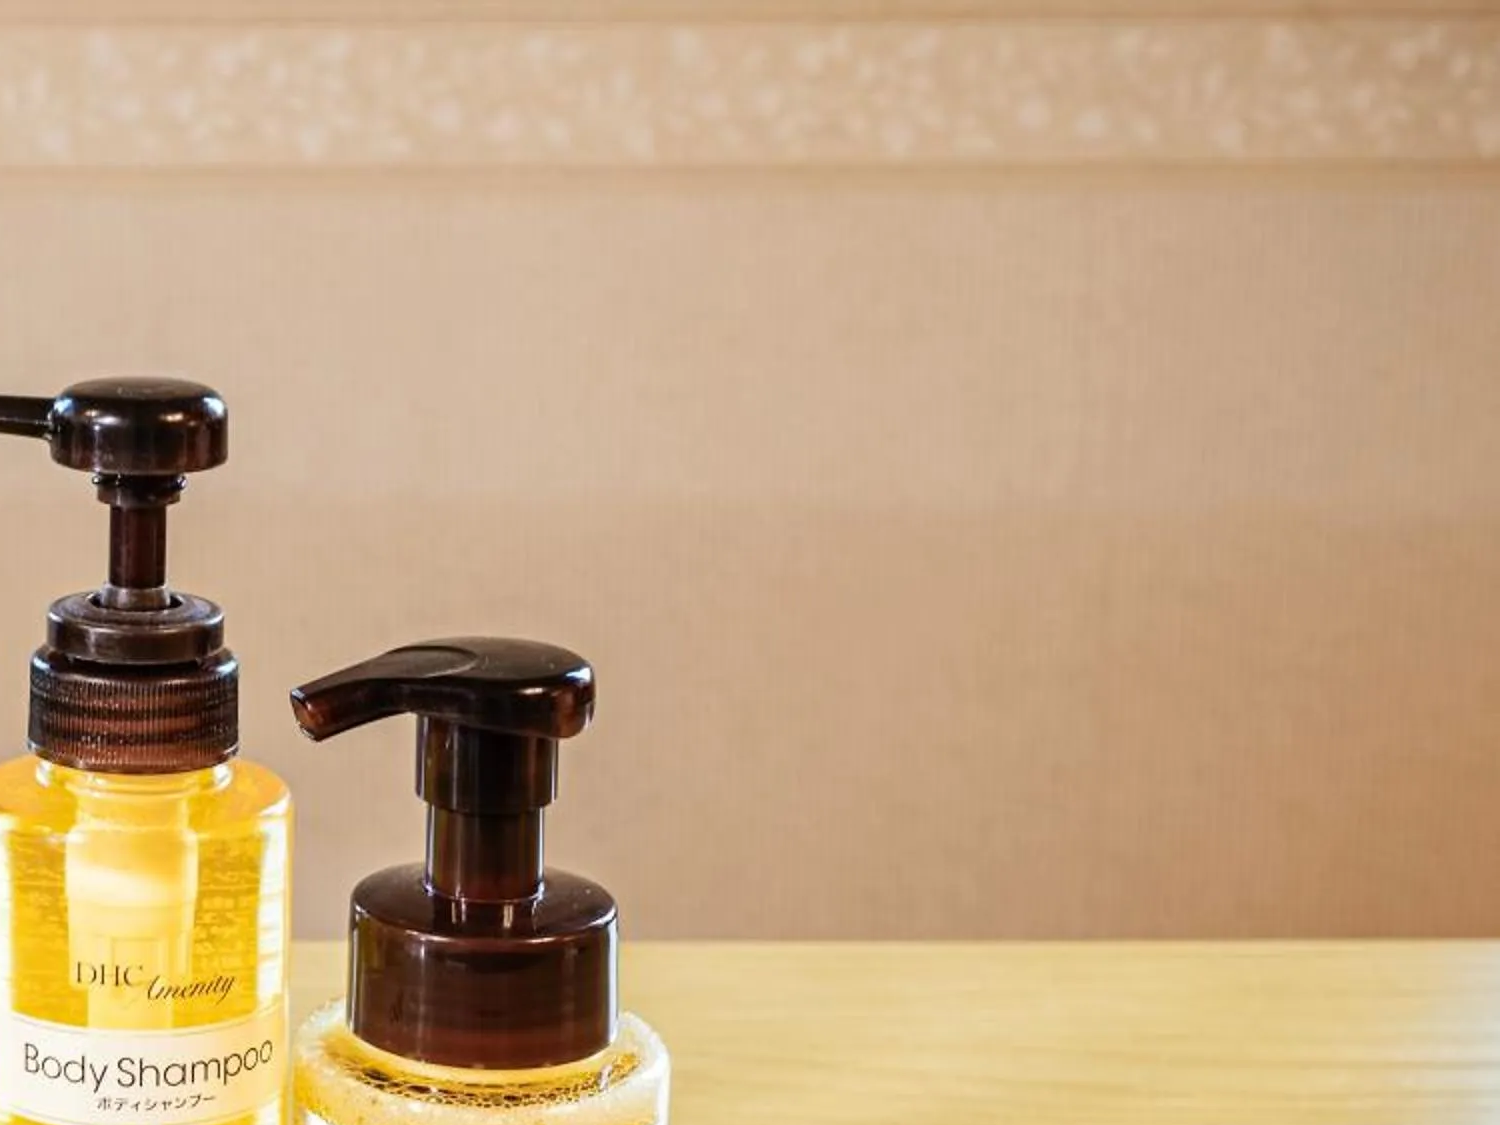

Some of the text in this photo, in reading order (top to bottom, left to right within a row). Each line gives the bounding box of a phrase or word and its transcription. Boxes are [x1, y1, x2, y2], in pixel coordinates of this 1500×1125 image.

[76, 961, 143, 987] DHC
[24, 1040, 273, 1093] Body Shampoo
